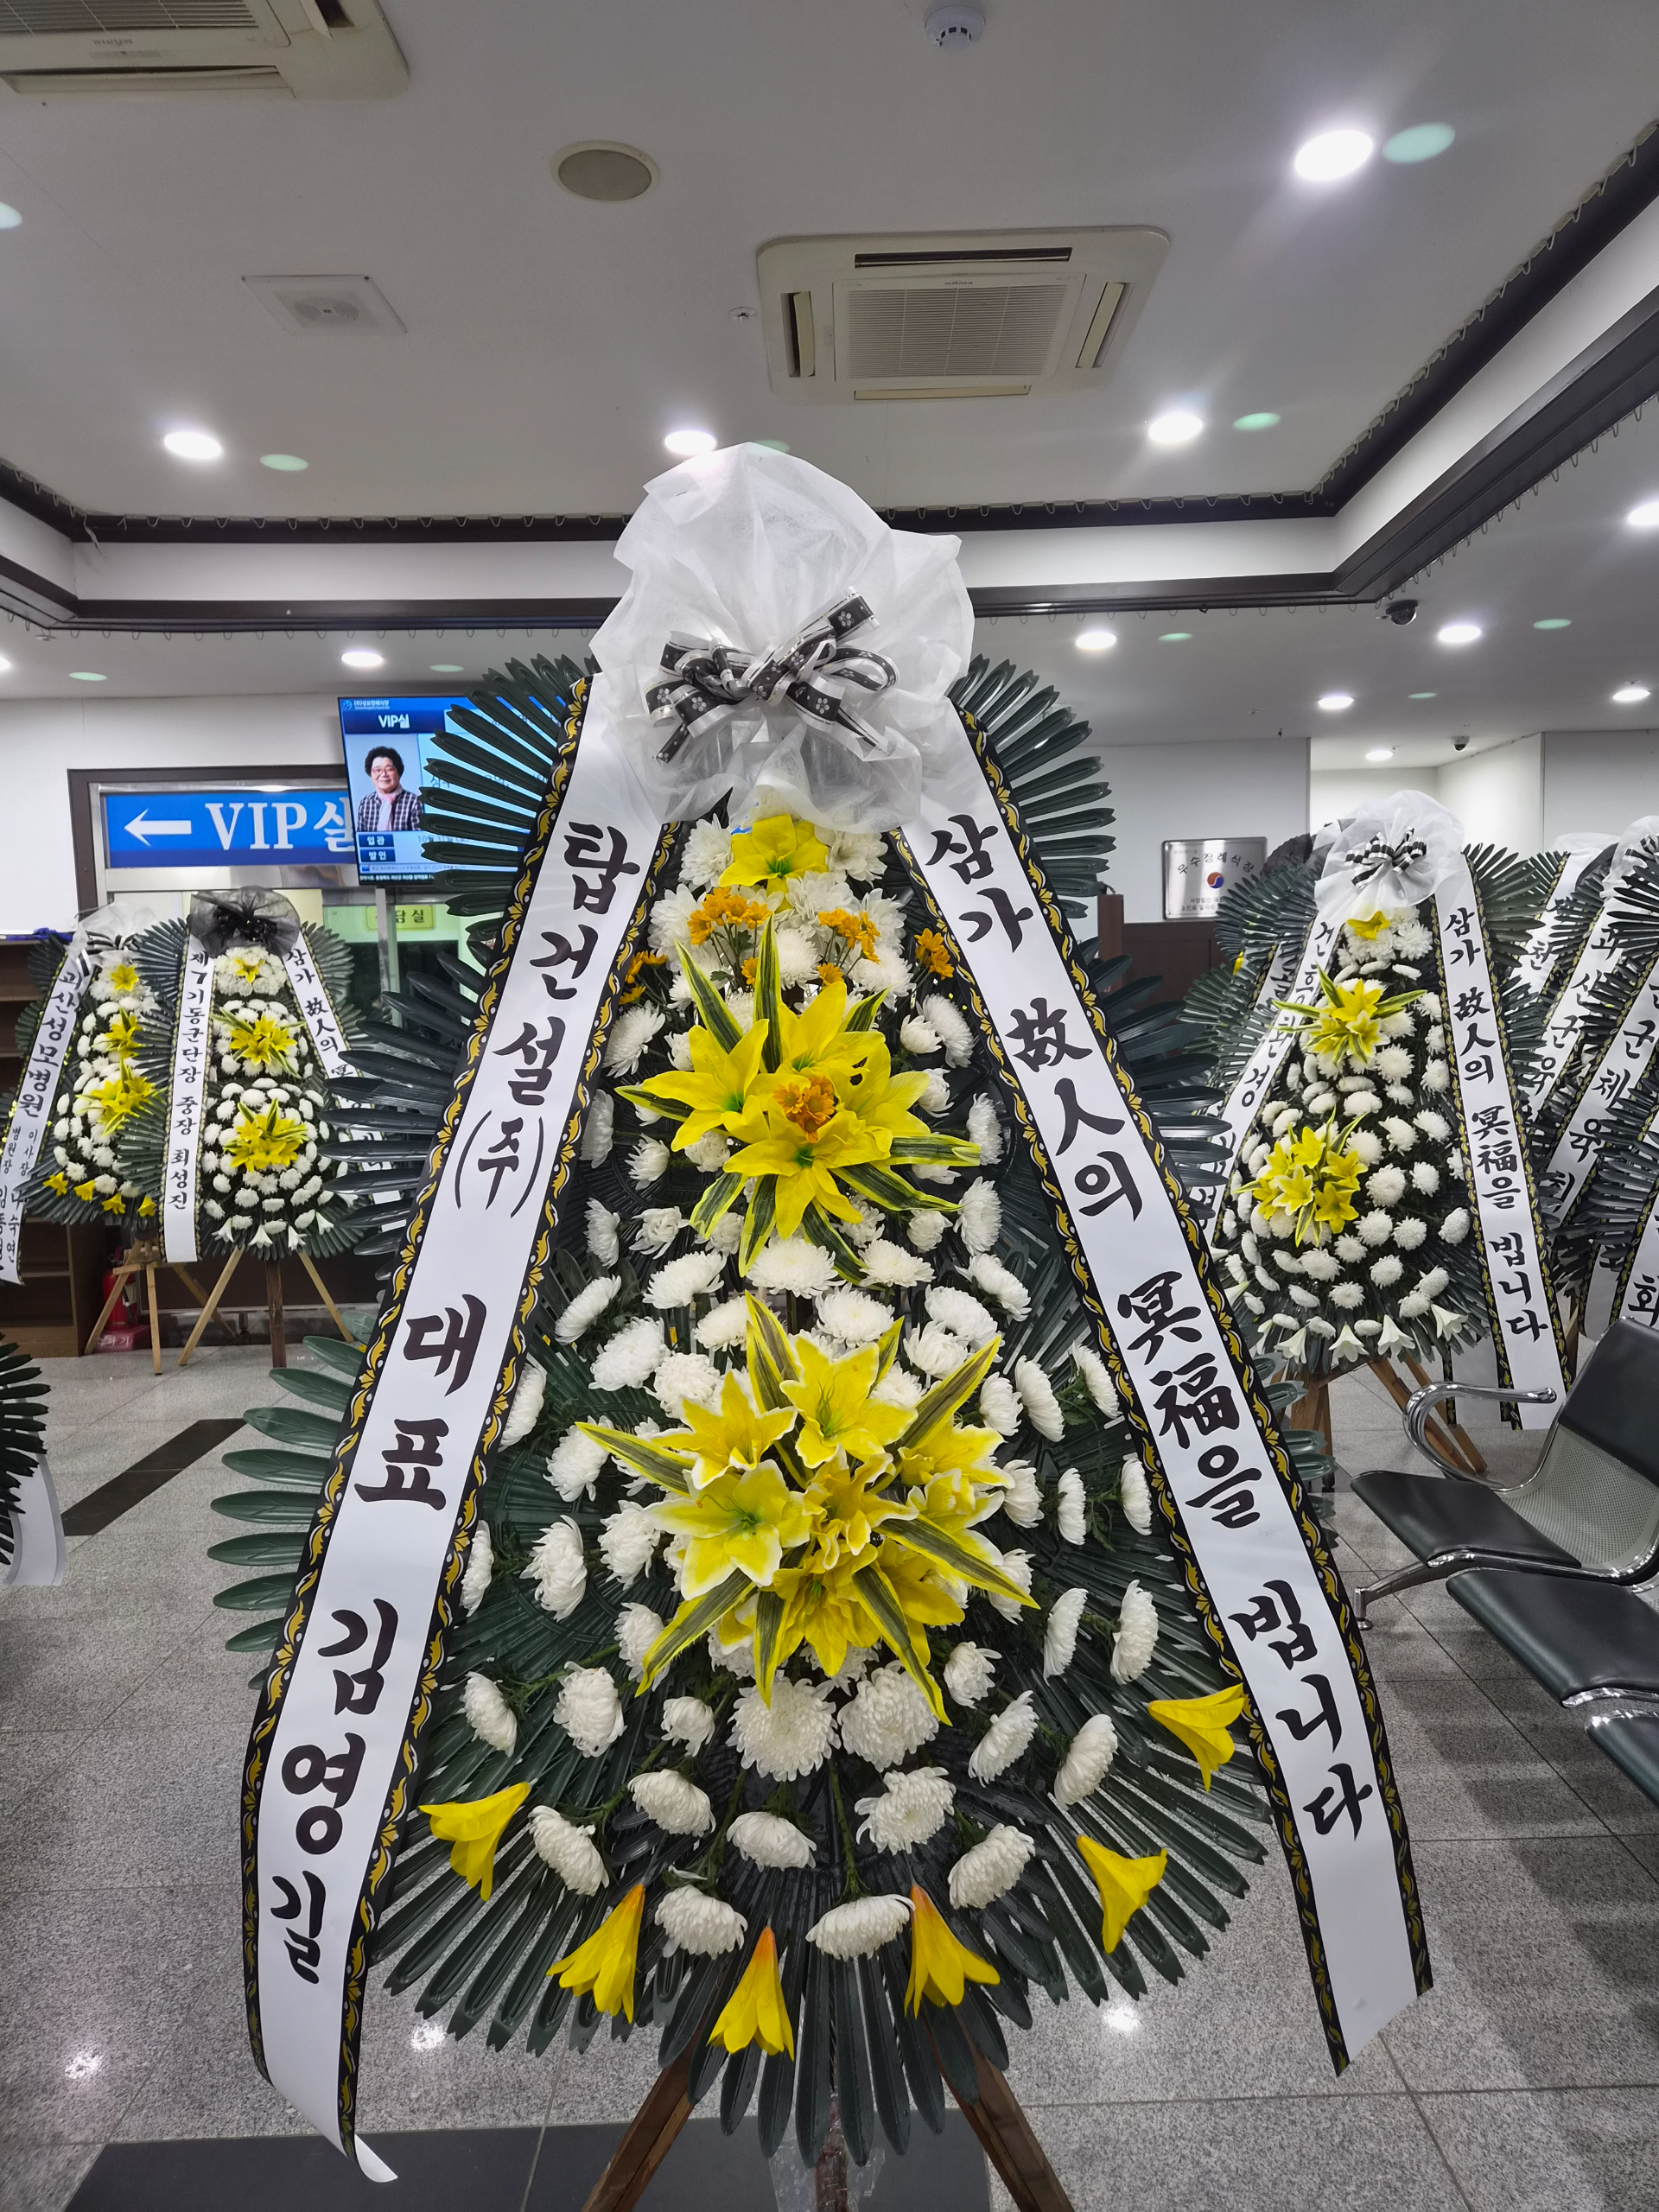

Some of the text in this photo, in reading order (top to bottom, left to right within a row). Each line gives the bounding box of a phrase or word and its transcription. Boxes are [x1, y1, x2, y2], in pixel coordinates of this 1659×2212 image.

[378, 714, 410, 728] VIP실
[205, 797, 355, 852] VIP실
[395, 909, 424, 923] 담실
[19, 970, 82, 1117] 괴산성모병원
[287, 948, 339, 1052] 삼가 故人의
[454, 821, 641, 1218] 탑건설(주)
[20, 1128, 38, 1177] 이사장
[174, 1096, 199, 1135] 중장
[1444, 907, 1549, 1343] 삼가 故人의 冥福을 빕니다
[168, 1148, 190, 1210] 최성진
[925, 814, 1373, 1841] 삼가 故人의 冥福을 빕니다
[353, 1294, 486, 1510] 대표
[270, 1598, 399, 1985] 김영길
